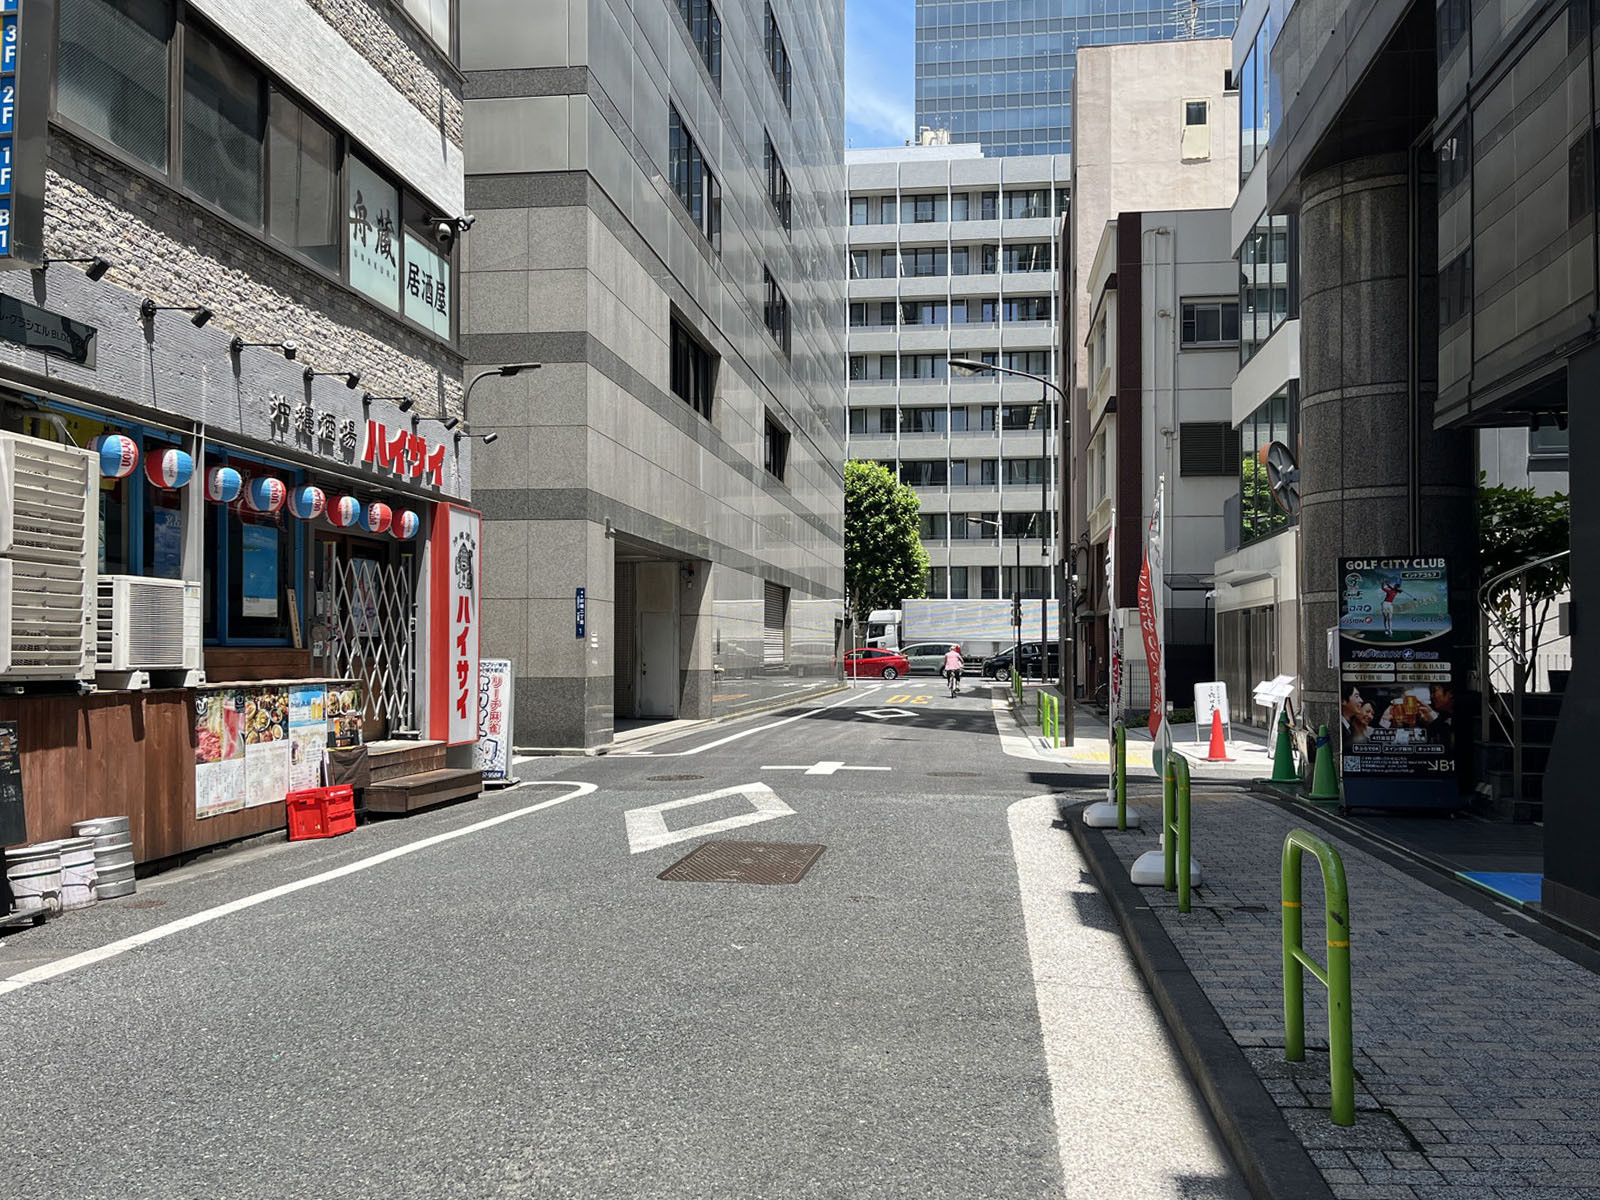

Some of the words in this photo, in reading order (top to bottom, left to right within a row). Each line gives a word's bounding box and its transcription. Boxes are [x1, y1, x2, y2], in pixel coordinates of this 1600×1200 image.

[5, 25, 17, 63] 3F
[2, 86, 14, 124] 2F
[0, 147, 11, 185] 1F
[407, 261, 447, 317] 居酒屋
[269, 393, 357, 449] 沖縄酒場
[361, 419, 446, 487] ハイサイ
[1345, 560, 1378, 571] GOLF
[1380, 559, 1410, 570] CITY
[1412, 557, 1446, 569] CLUB
[456, 595, 470, 719] ハイサイ
[1440, 759, 1456, 771] B1
